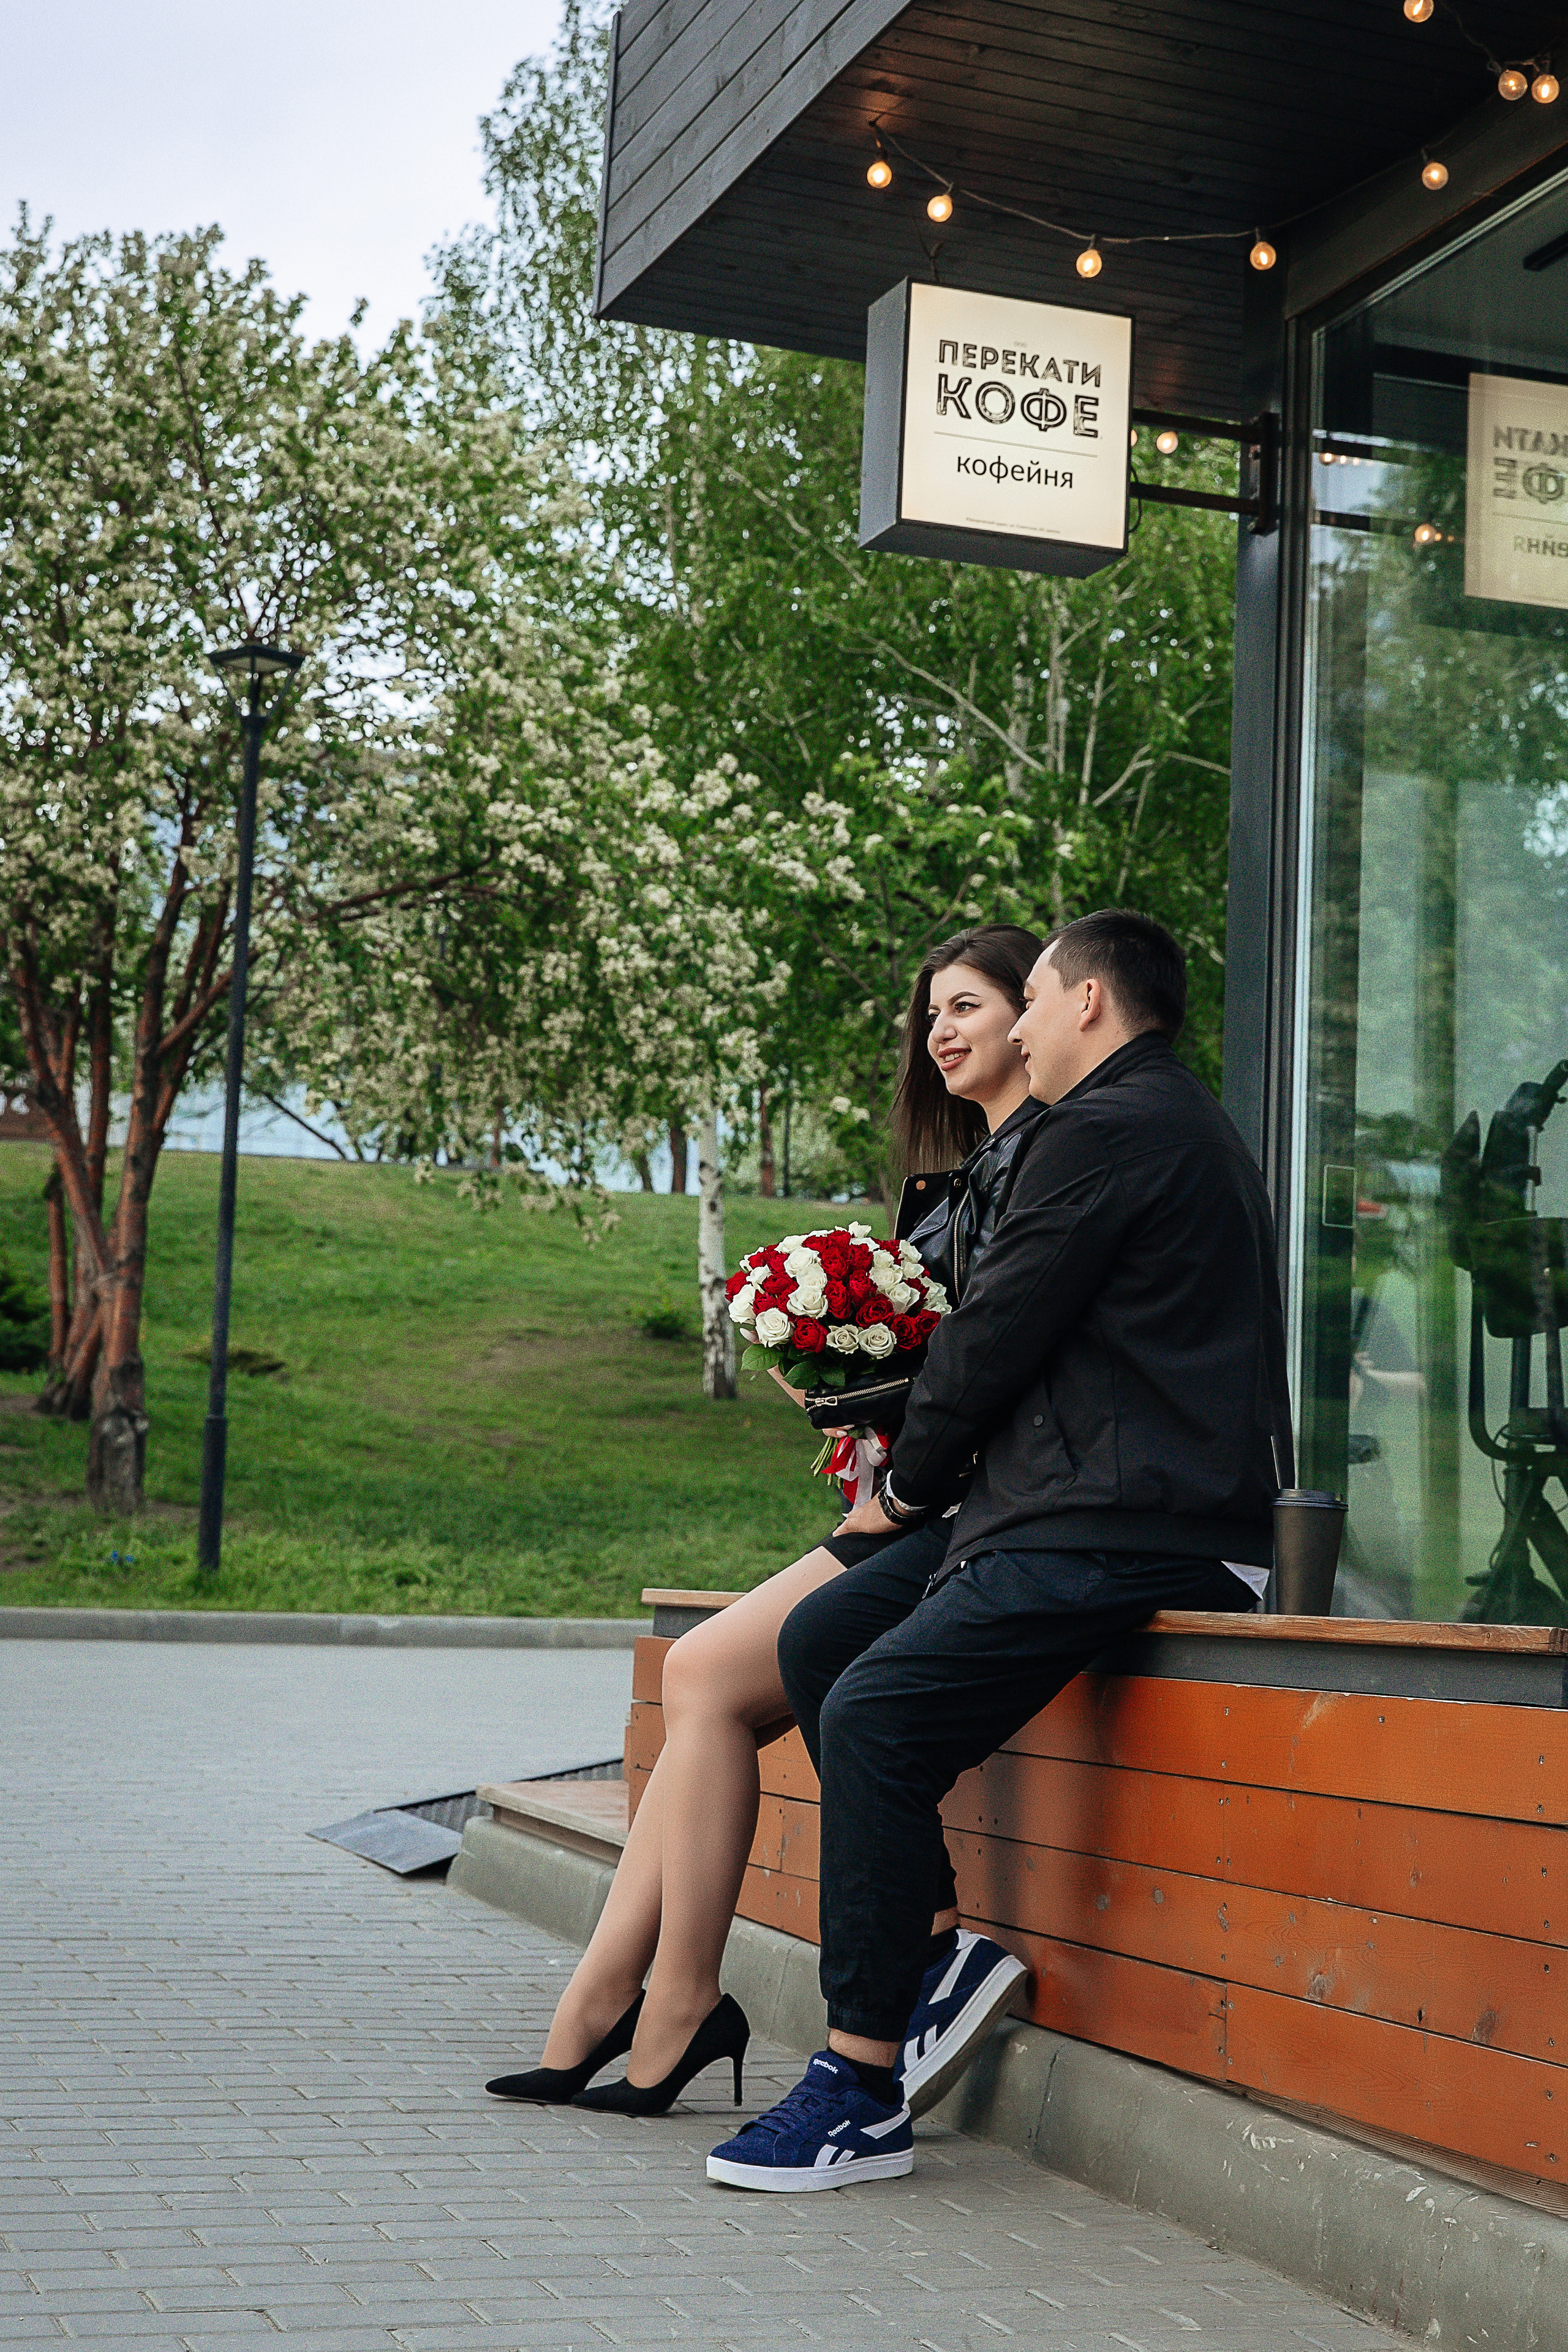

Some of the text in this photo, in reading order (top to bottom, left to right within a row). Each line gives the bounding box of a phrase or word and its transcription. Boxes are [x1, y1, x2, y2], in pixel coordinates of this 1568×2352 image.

[938, 339, 1102, 388] ПЕРЕКАТИ
[936, 374, 1099, 438] КОФЕ
[957, 456, 1074, 489] кофейня
[813, 2058, 839, 2074] Reebok
[827, 2119, 851, 2138] Reebok
